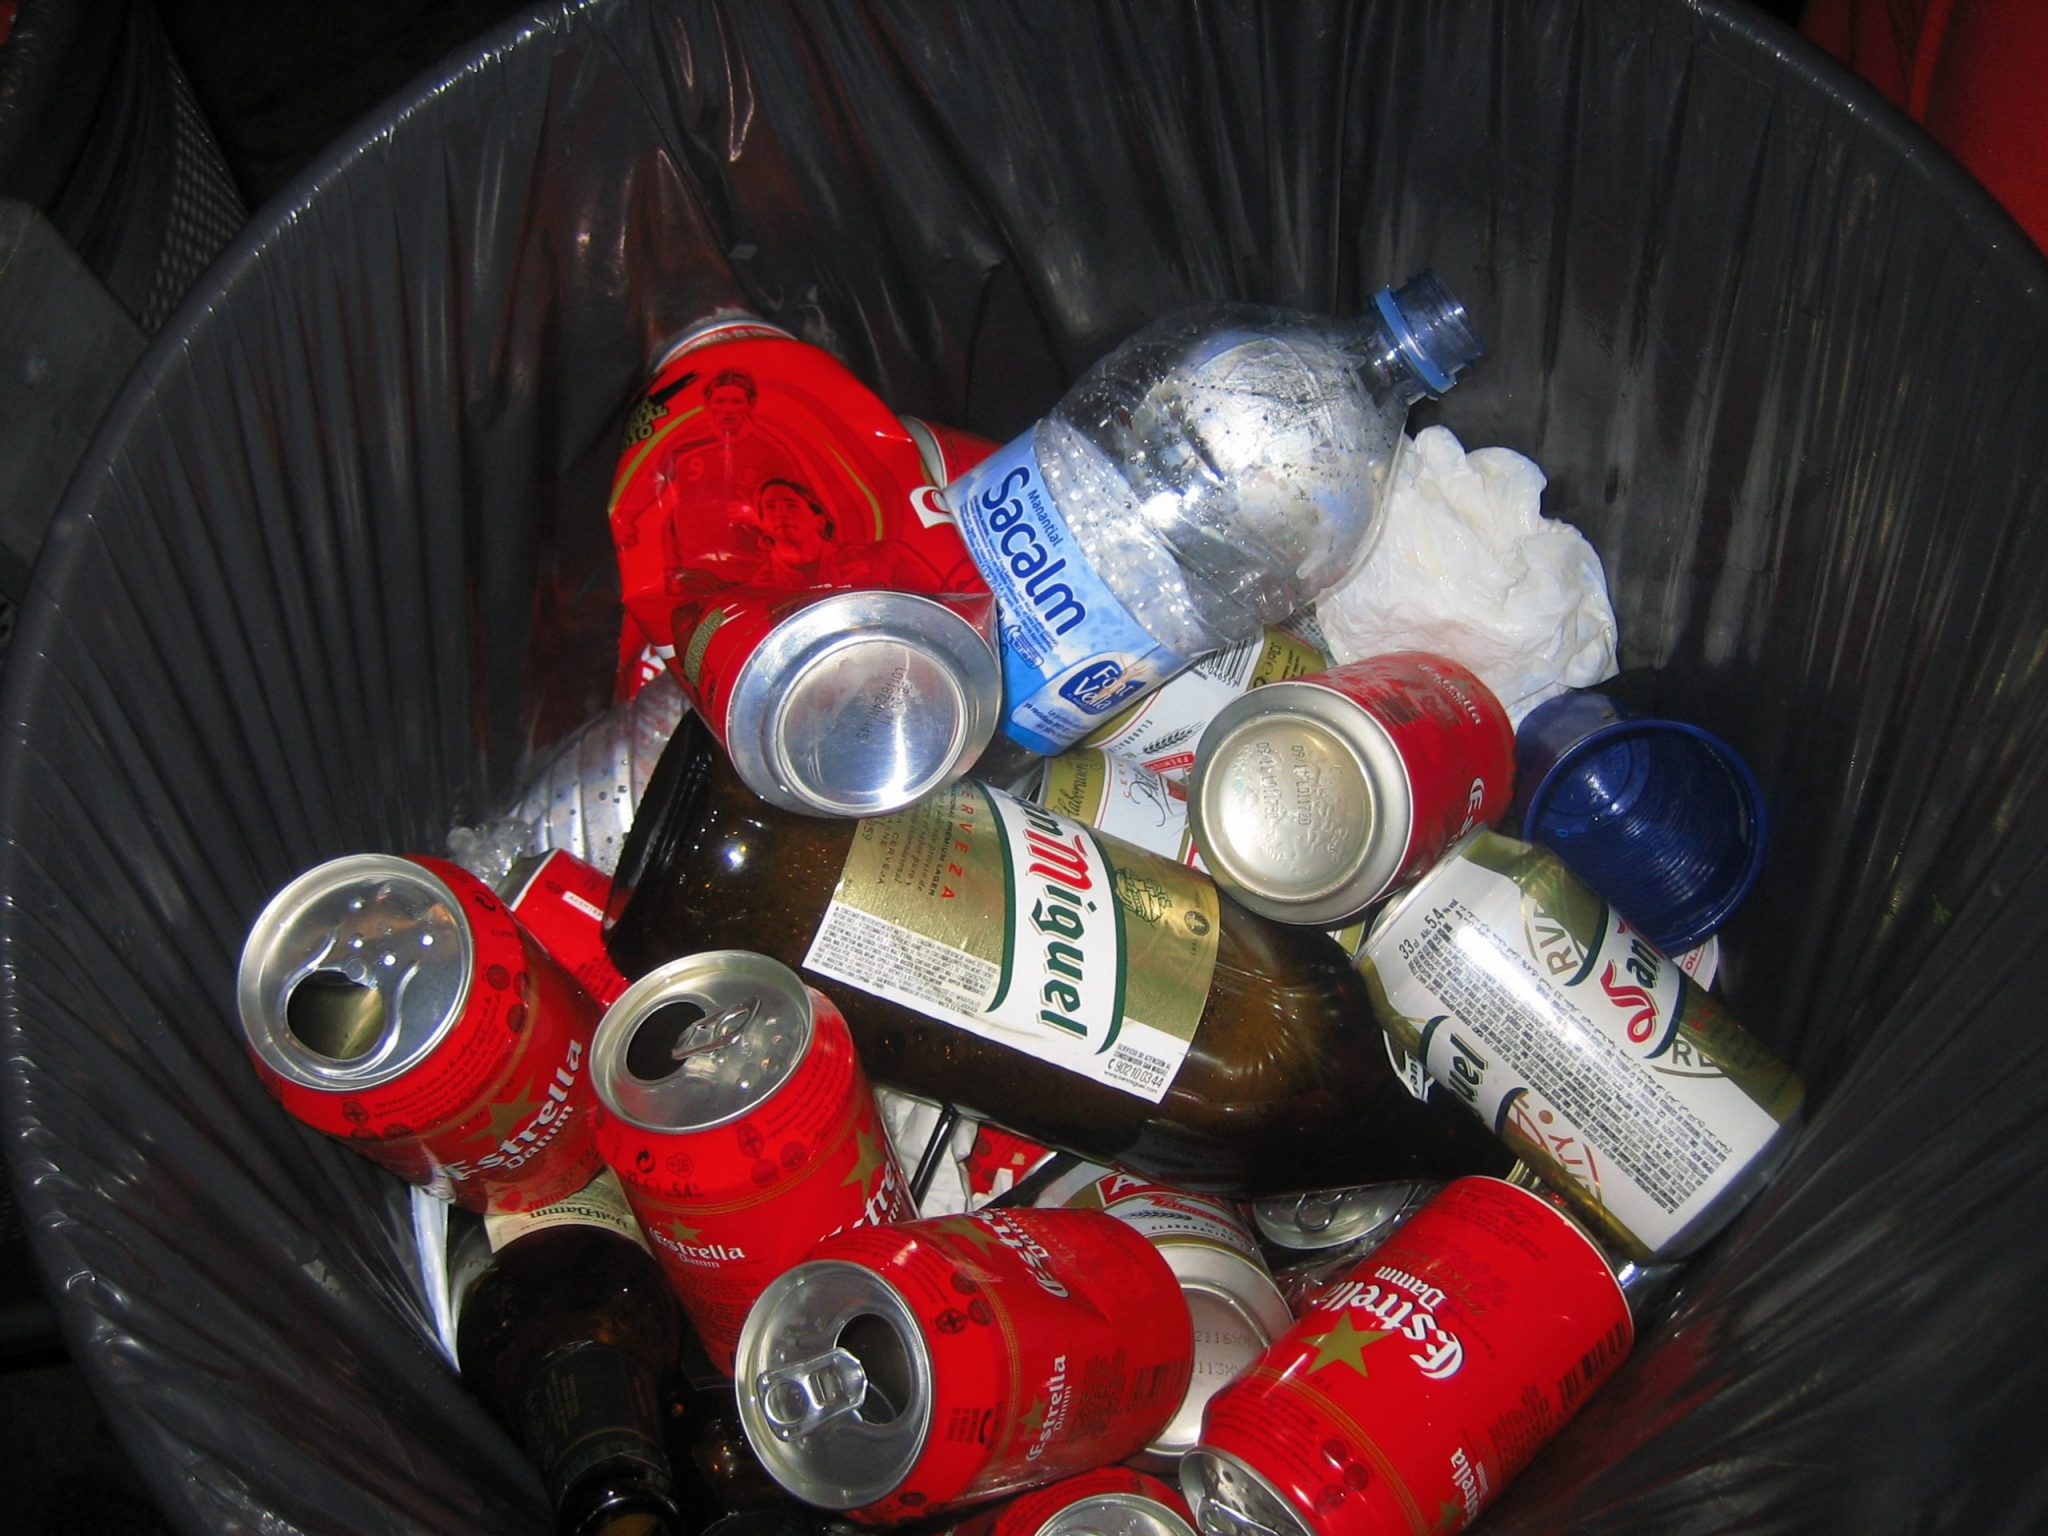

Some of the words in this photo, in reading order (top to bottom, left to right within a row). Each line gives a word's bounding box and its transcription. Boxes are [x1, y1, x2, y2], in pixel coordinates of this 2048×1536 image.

[1024, 488, 1065, 548] Manantial
[981, 470, 1088, 636] Sacalm
[1072, 675, 1110, 711] Vella
[1091, 663, 1135, 699] Font
[939, 821, 953, 861] PREMIUM
[1022, 829, 1096, 1036] Miguel
[1424, 908, 1446, 930] 5,4
[1598, 937, 1659, 1044] San
[439, 1037, 584, 1182] Estrella
[503, 1104, 575, 1172] Damm
[649, 1224, 746, 1262] Estrella
[678, 1252, 722, 1270] Damm
[1375, 1265, 1446, 1311] Damm
[1026, 1354, 1069, 1463] Estrella
[1054, 1385, 1072, 1432] Damm
